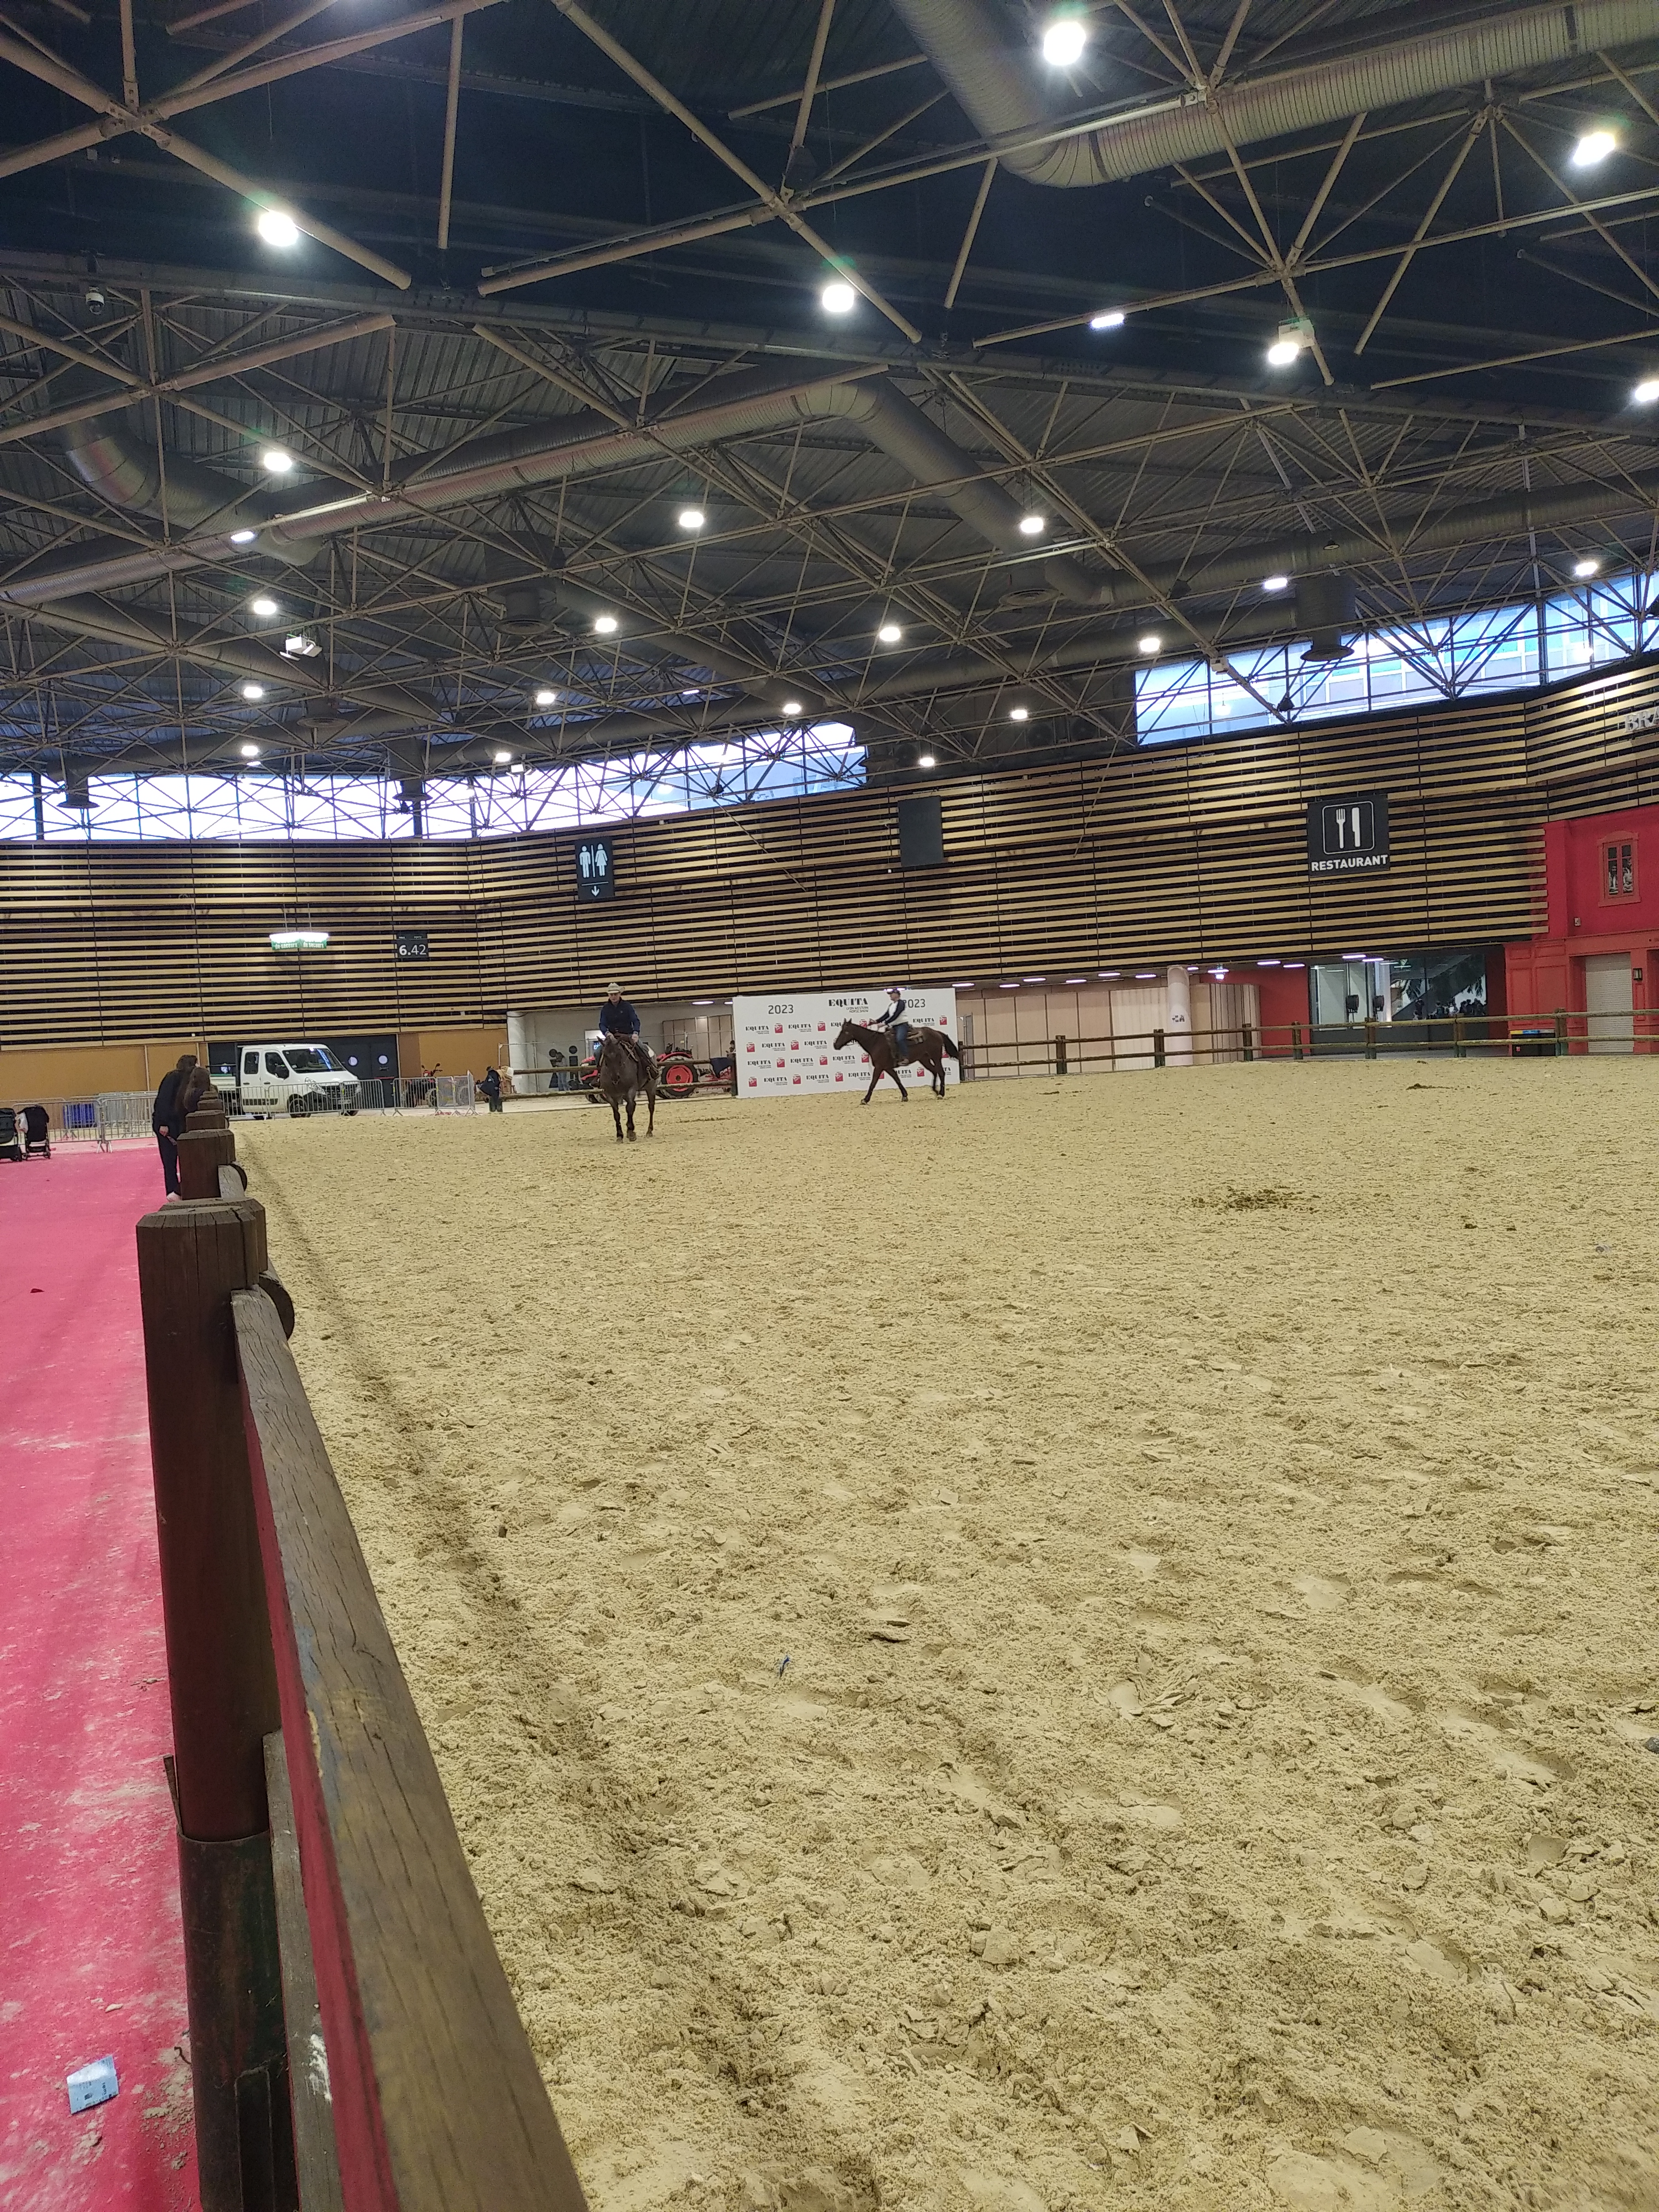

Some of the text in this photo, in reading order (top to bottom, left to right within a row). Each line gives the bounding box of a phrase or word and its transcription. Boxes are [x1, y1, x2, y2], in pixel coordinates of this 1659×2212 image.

[1311, 854, 1388, 872] RESTAURANT
[399, 945, 426, 956] 6.42
[828, 998, 868, 1008] EQUITA
[768, 1004, 794, 1014] 2023
